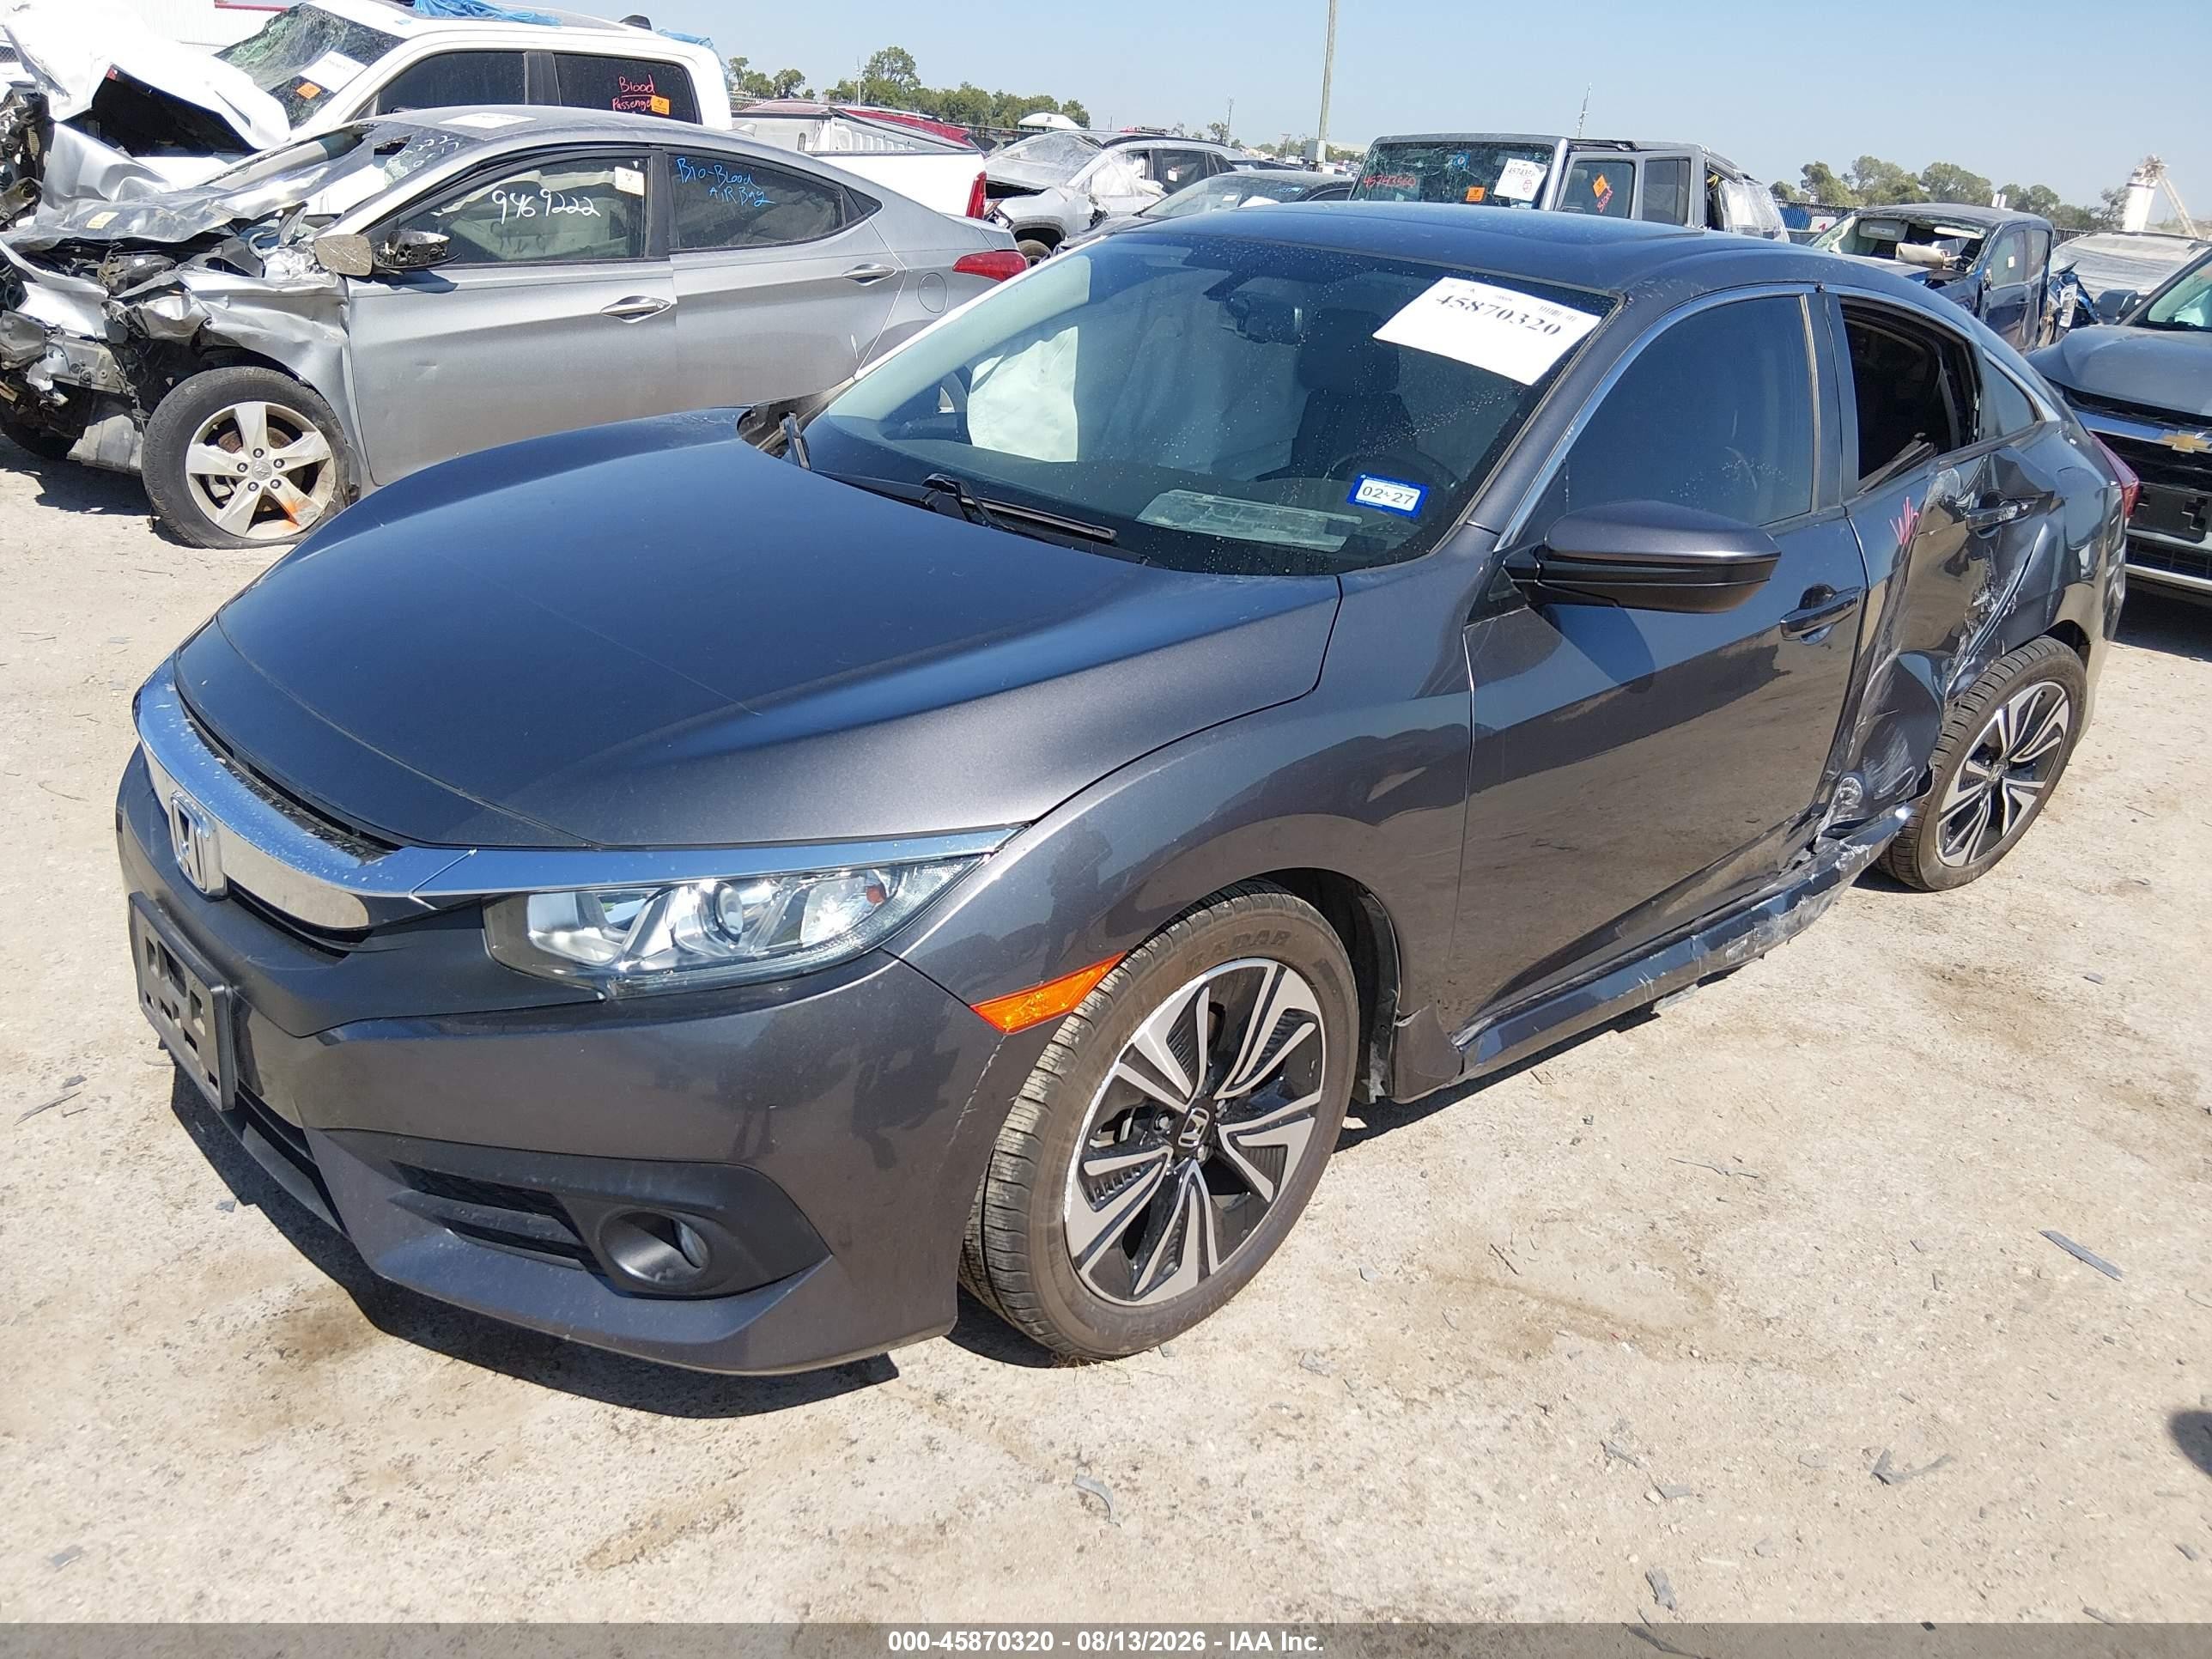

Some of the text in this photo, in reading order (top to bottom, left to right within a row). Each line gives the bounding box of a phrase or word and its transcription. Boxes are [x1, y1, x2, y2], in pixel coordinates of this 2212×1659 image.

[618, 74, 655, 94] Blood
[612, 97, 652, 112] Passenge
[1436, 295, 1562, 336] 45870320
